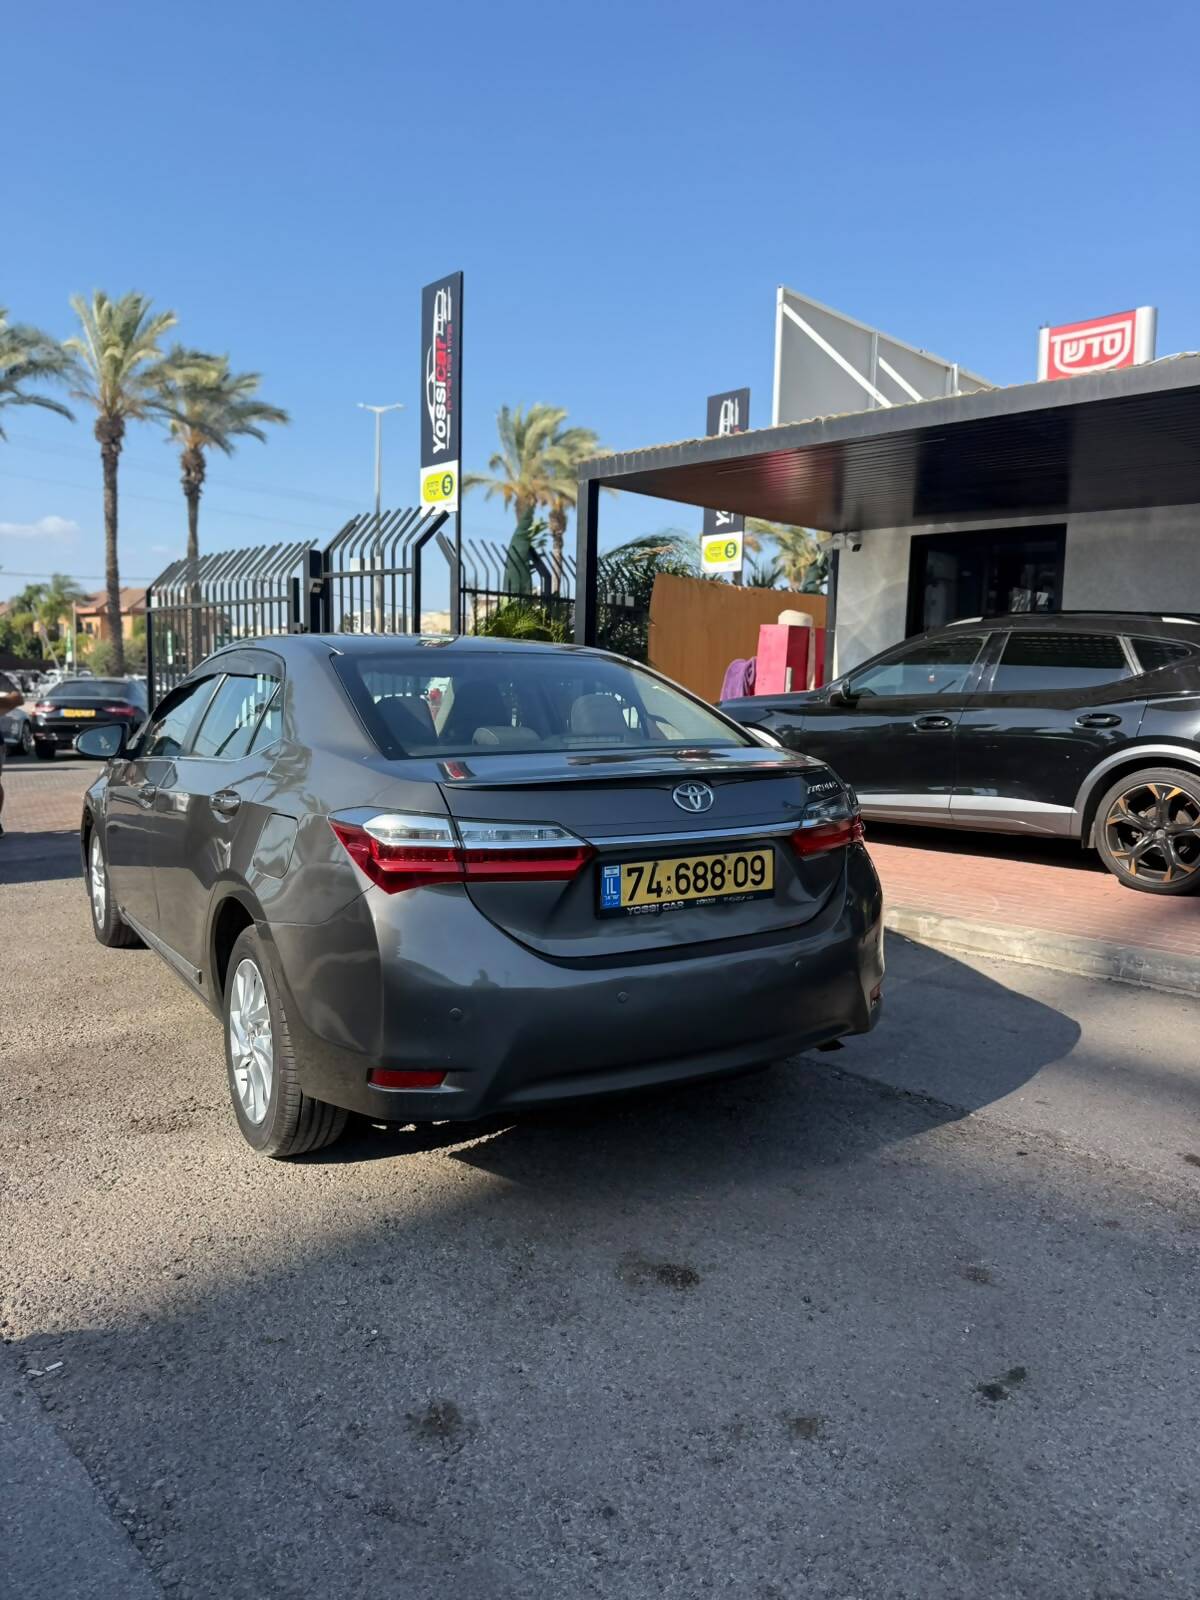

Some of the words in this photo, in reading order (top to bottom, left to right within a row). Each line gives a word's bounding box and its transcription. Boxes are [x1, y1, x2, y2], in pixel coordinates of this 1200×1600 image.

[606, 878, 617, 895] IL
[627, 904, 660, 917] YOSSI
[662, 901, 684, 912] CAR
